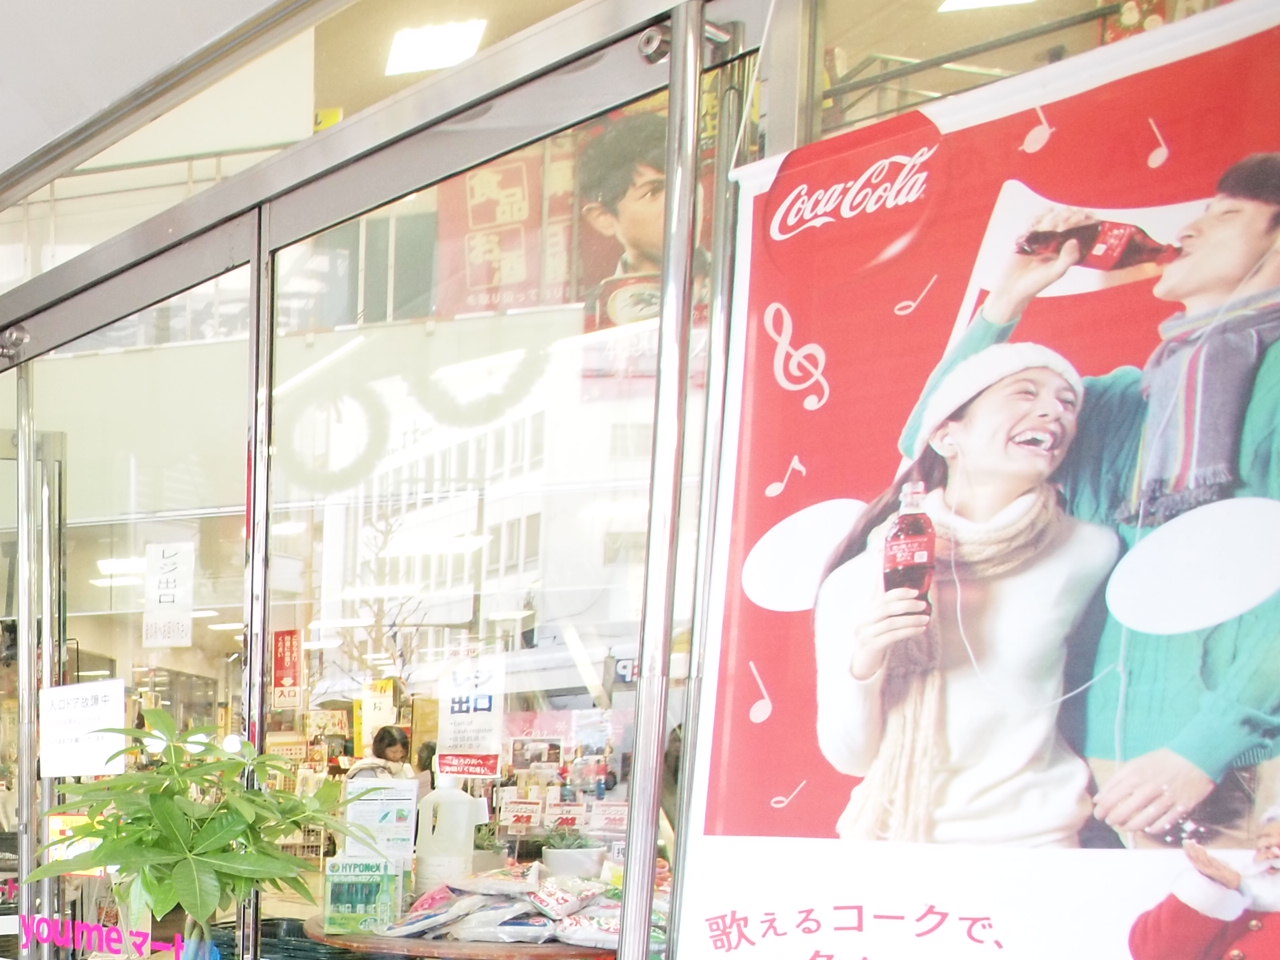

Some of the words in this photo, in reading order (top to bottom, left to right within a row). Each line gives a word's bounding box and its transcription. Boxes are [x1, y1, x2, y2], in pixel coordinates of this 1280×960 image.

[769, 145, 939, 241] Coca-Cola
[278, 690, 297, 698] 入口
[450, 694, 494, 714] 出口
[20, 913, 124, 955] youme
[705, 903, 1004, 953] 歌えるコークで、
